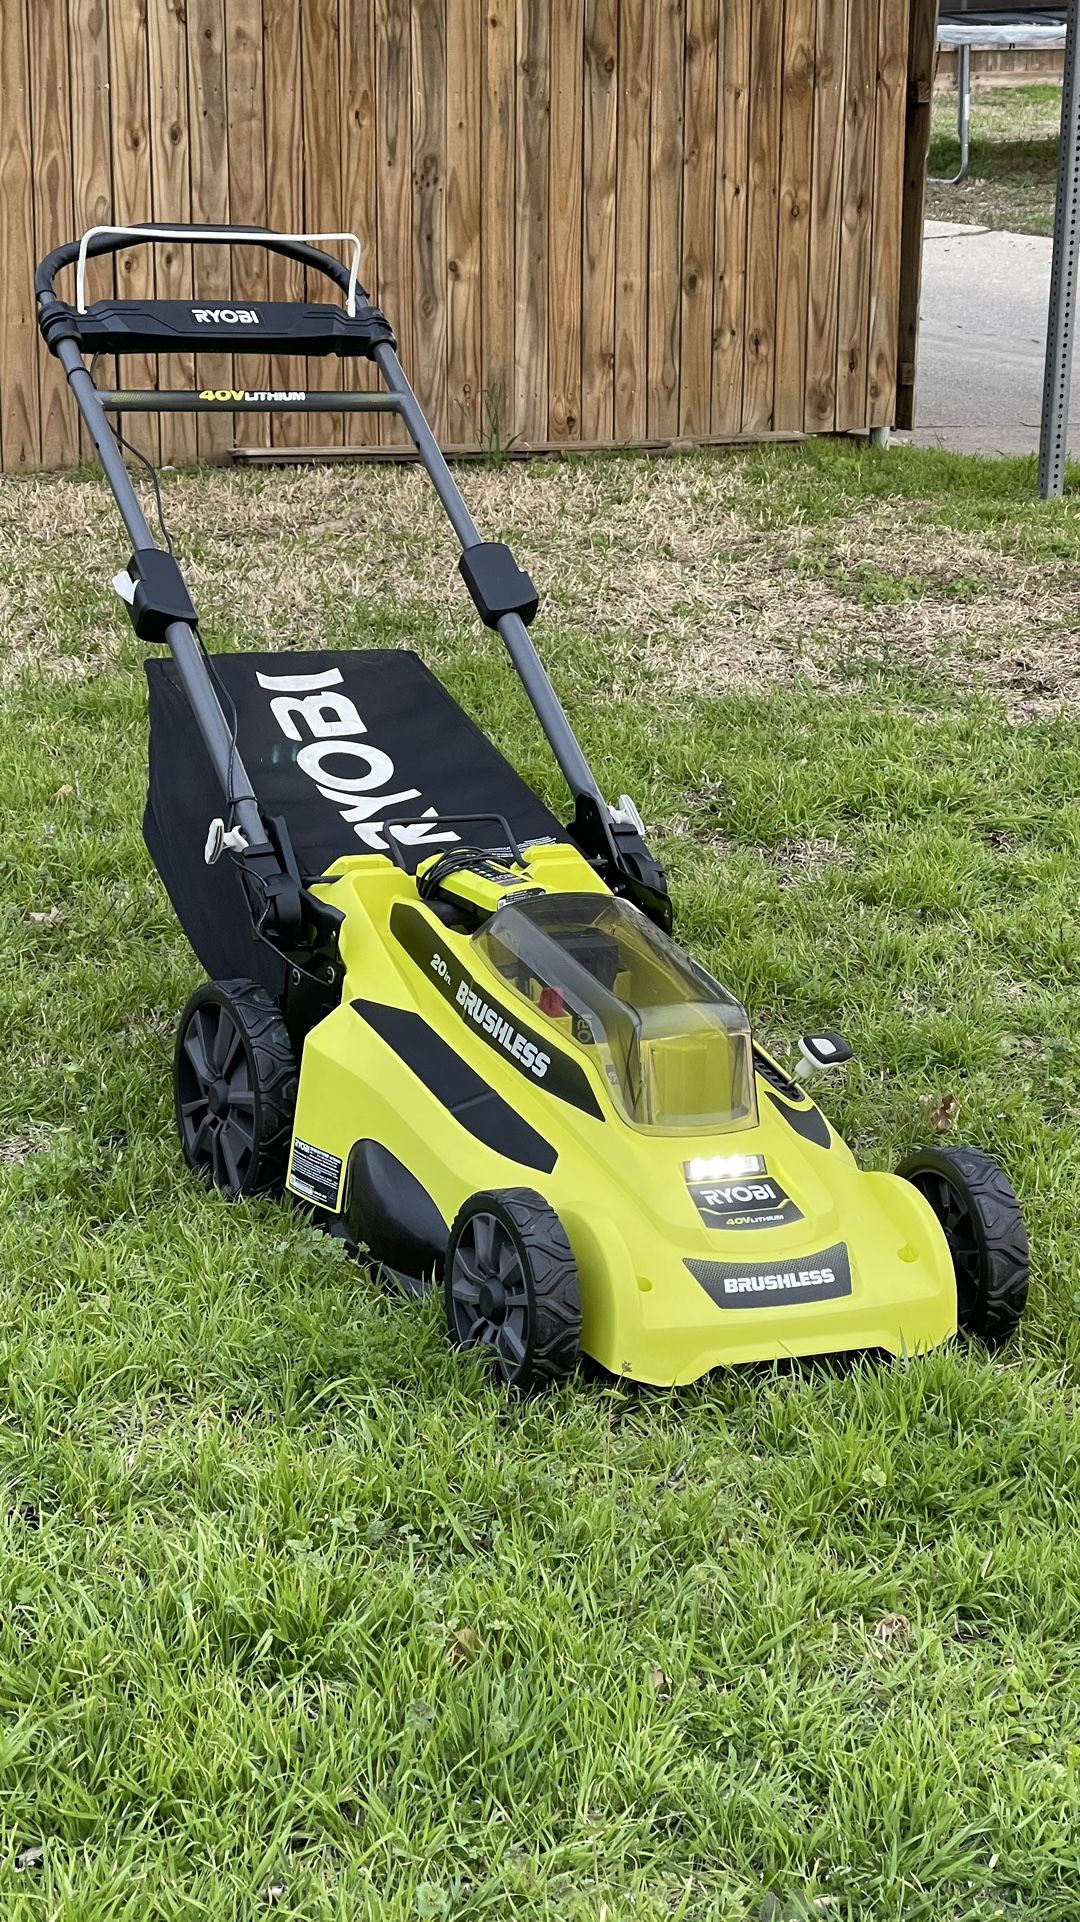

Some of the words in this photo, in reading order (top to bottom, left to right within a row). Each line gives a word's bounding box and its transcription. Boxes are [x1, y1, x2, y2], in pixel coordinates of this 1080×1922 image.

[191, 309, 259, 323] RYOBI
[255, 667, 461, 850] RYOBI
[455, 980, 551, 1078] BRUSHLESS
[699, 1184, 776, 1206] RYOBI
[723, 1268, 835, 1294] BRUSHLESS
